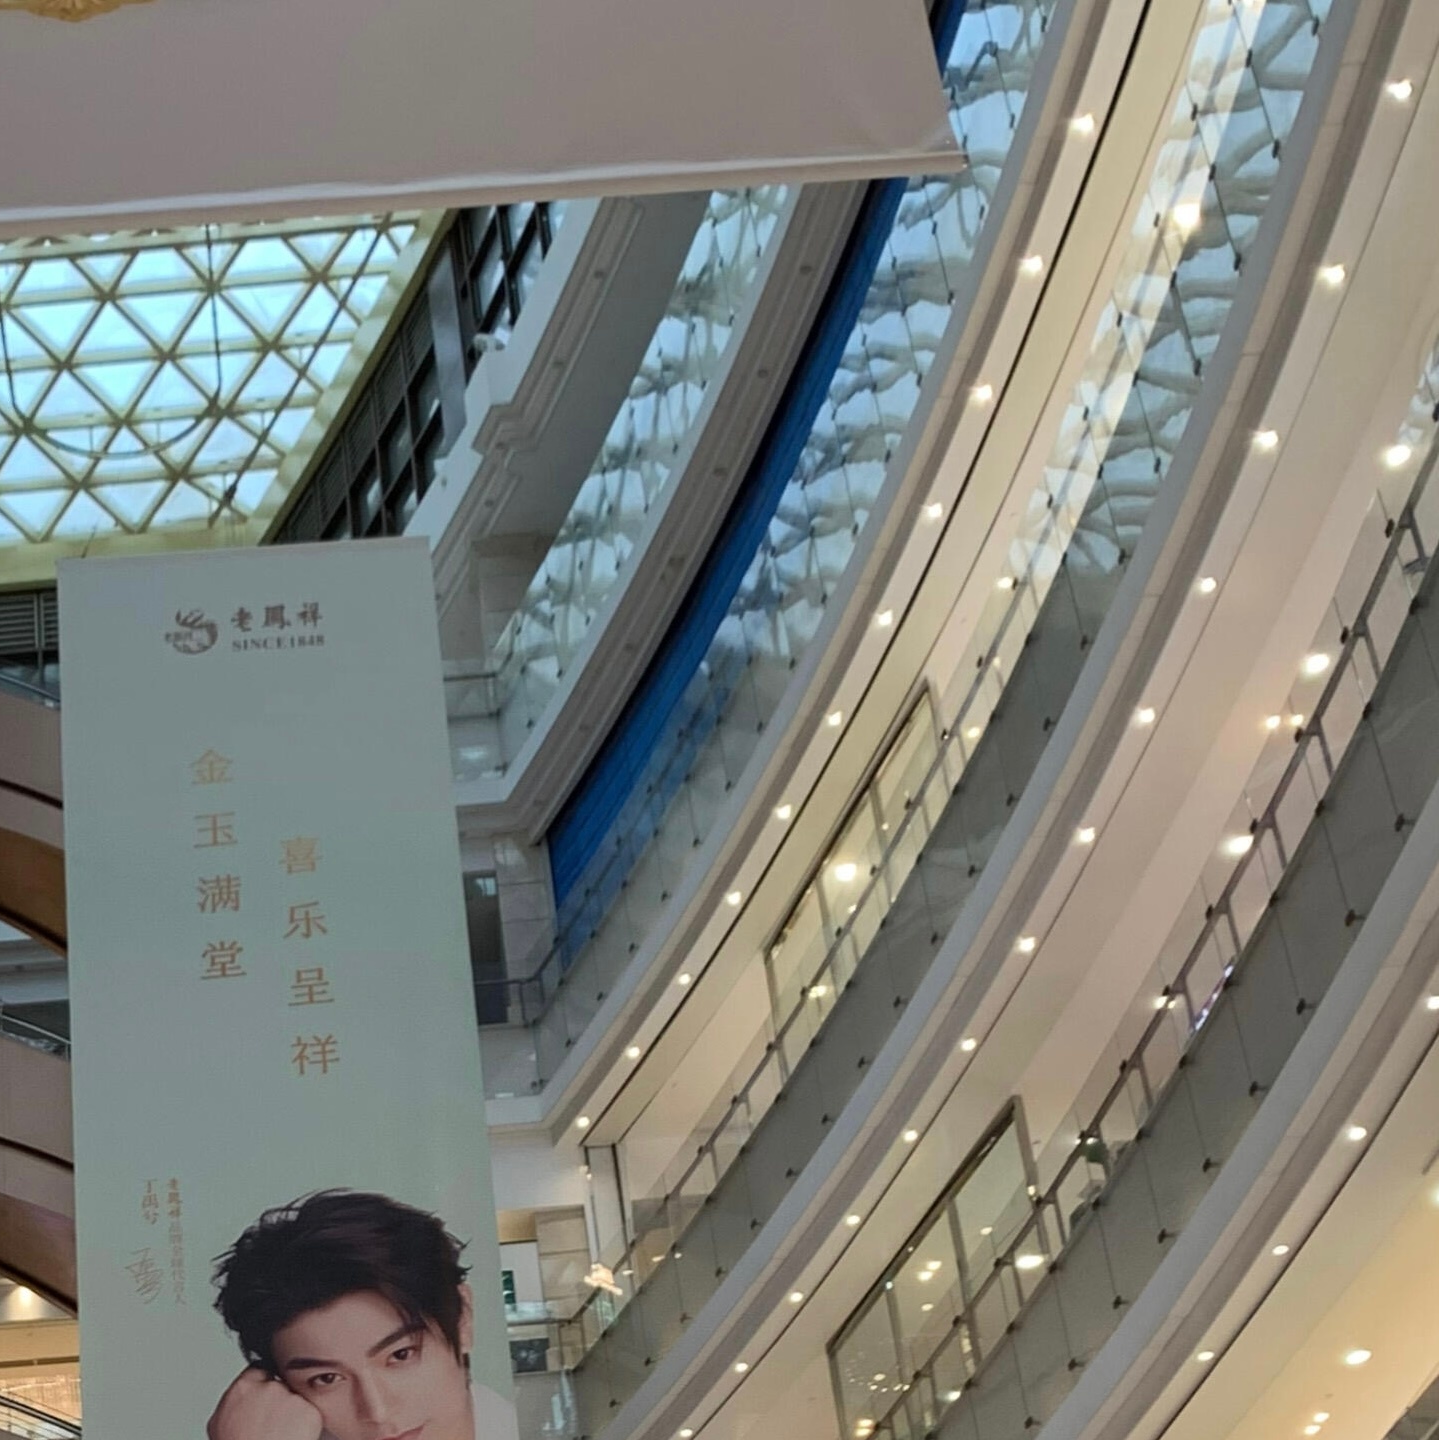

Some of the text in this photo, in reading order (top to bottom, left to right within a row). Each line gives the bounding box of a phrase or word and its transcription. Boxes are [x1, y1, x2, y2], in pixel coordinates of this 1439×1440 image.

[190, 747, 247, 981] 金玉满堂
[279, 835, 341, 1076] 喜乐呈祥
